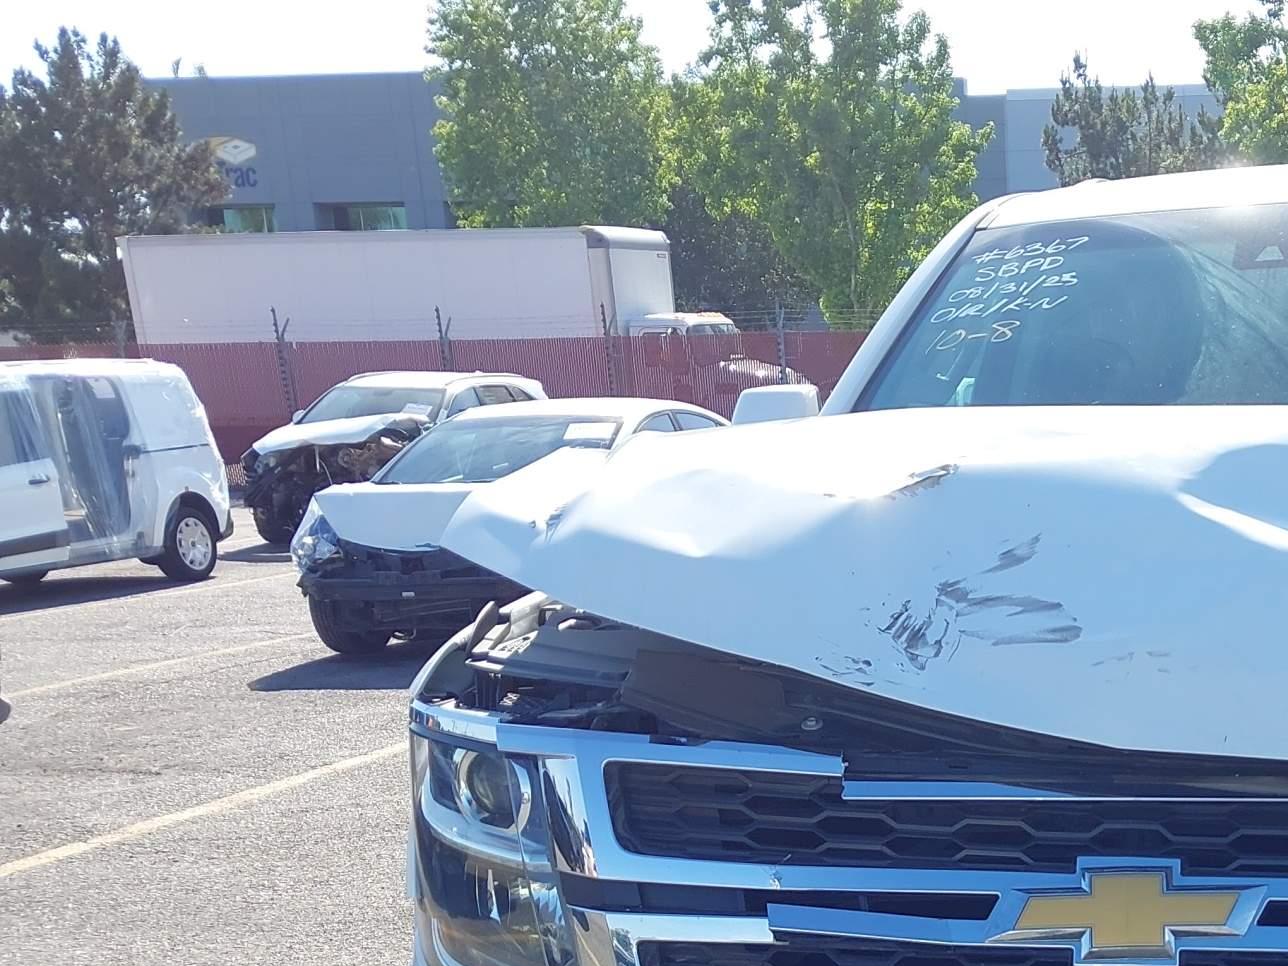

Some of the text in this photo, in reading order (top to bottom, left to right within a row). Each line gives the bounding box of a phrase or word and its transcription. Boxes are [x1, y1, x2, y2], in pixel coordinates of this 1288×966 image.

[216, 160, 258, 188] rac
[971, 235, 1090, 264] #6367
[974, 256, 1064, 282] SBPD
[925, 320, 1021, 354] 10-8
